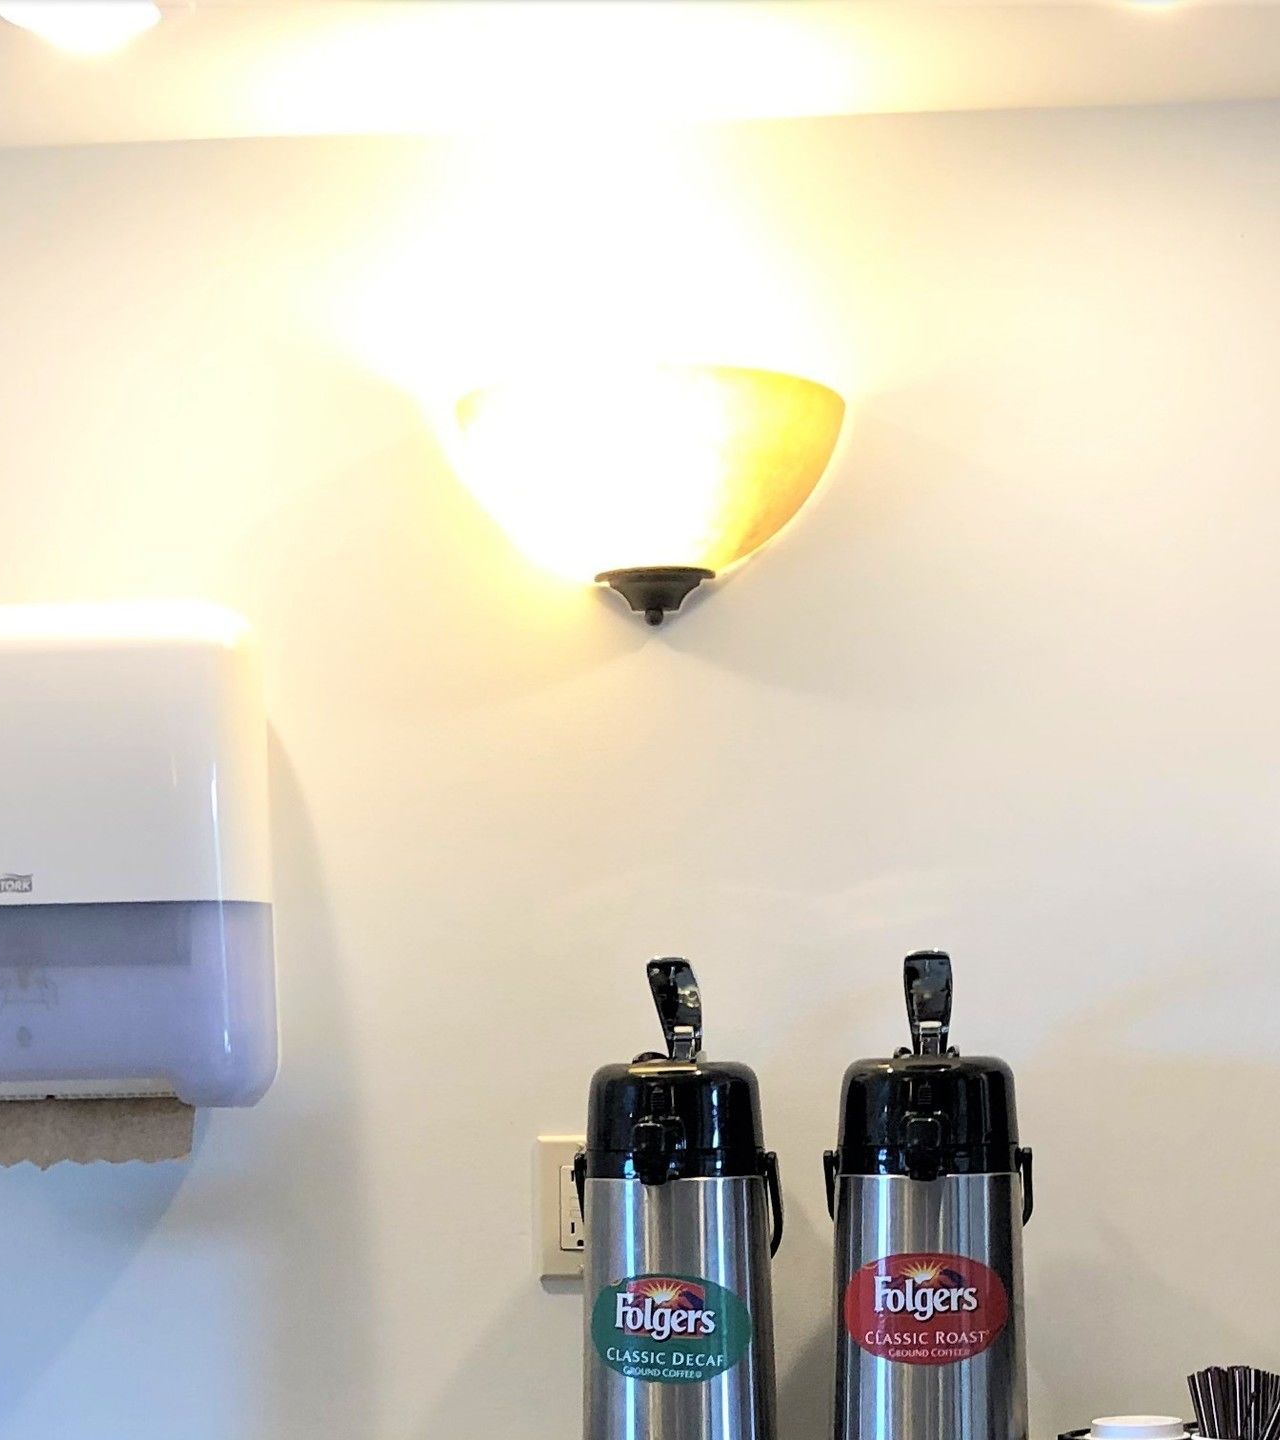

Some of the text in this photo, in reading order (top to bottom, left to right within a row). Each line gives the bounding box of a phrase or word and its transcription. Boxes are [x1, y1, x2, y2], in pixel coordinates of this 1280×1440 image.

[0, 879, 32, 892] TORK
[873, 1275, 979, 1322] Folgers
[615, 1292, 716, 1341] Folgers
[865, 1330, 929, 1346] CLASSIC
[606, 1346, 726, 1367] CLASSIC DECAF
[888, 1347, 930, 1358] GROUND
[623, 1365, 661, 1377] GROUND
